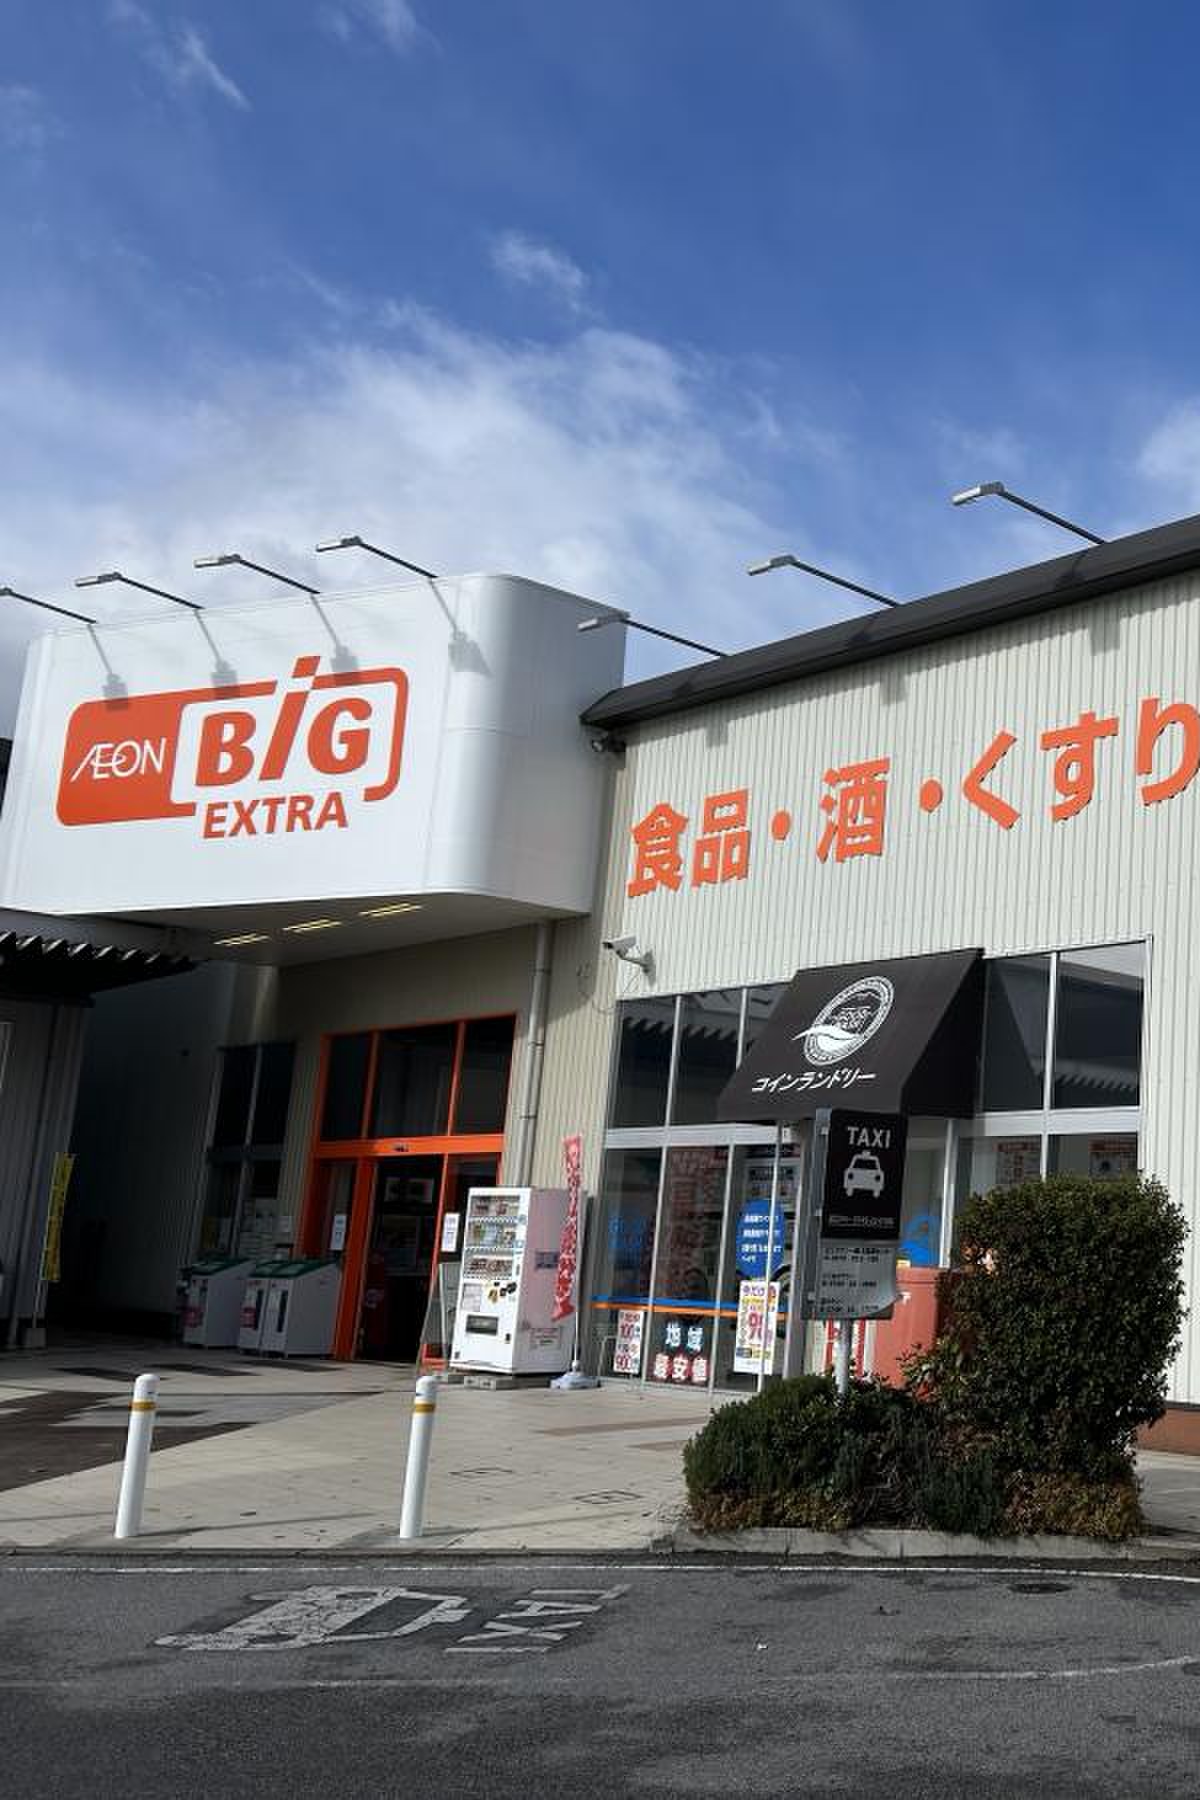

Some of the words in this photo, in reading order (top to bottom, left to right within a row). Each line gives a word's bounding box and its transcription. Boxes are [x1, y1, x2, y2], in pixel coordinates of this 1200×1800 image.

[202, 792, 349, 839] EXTRA
[751, 1068, 876, 1092] コインランドリー
[847, 1126, 892, 1149] TAXI
